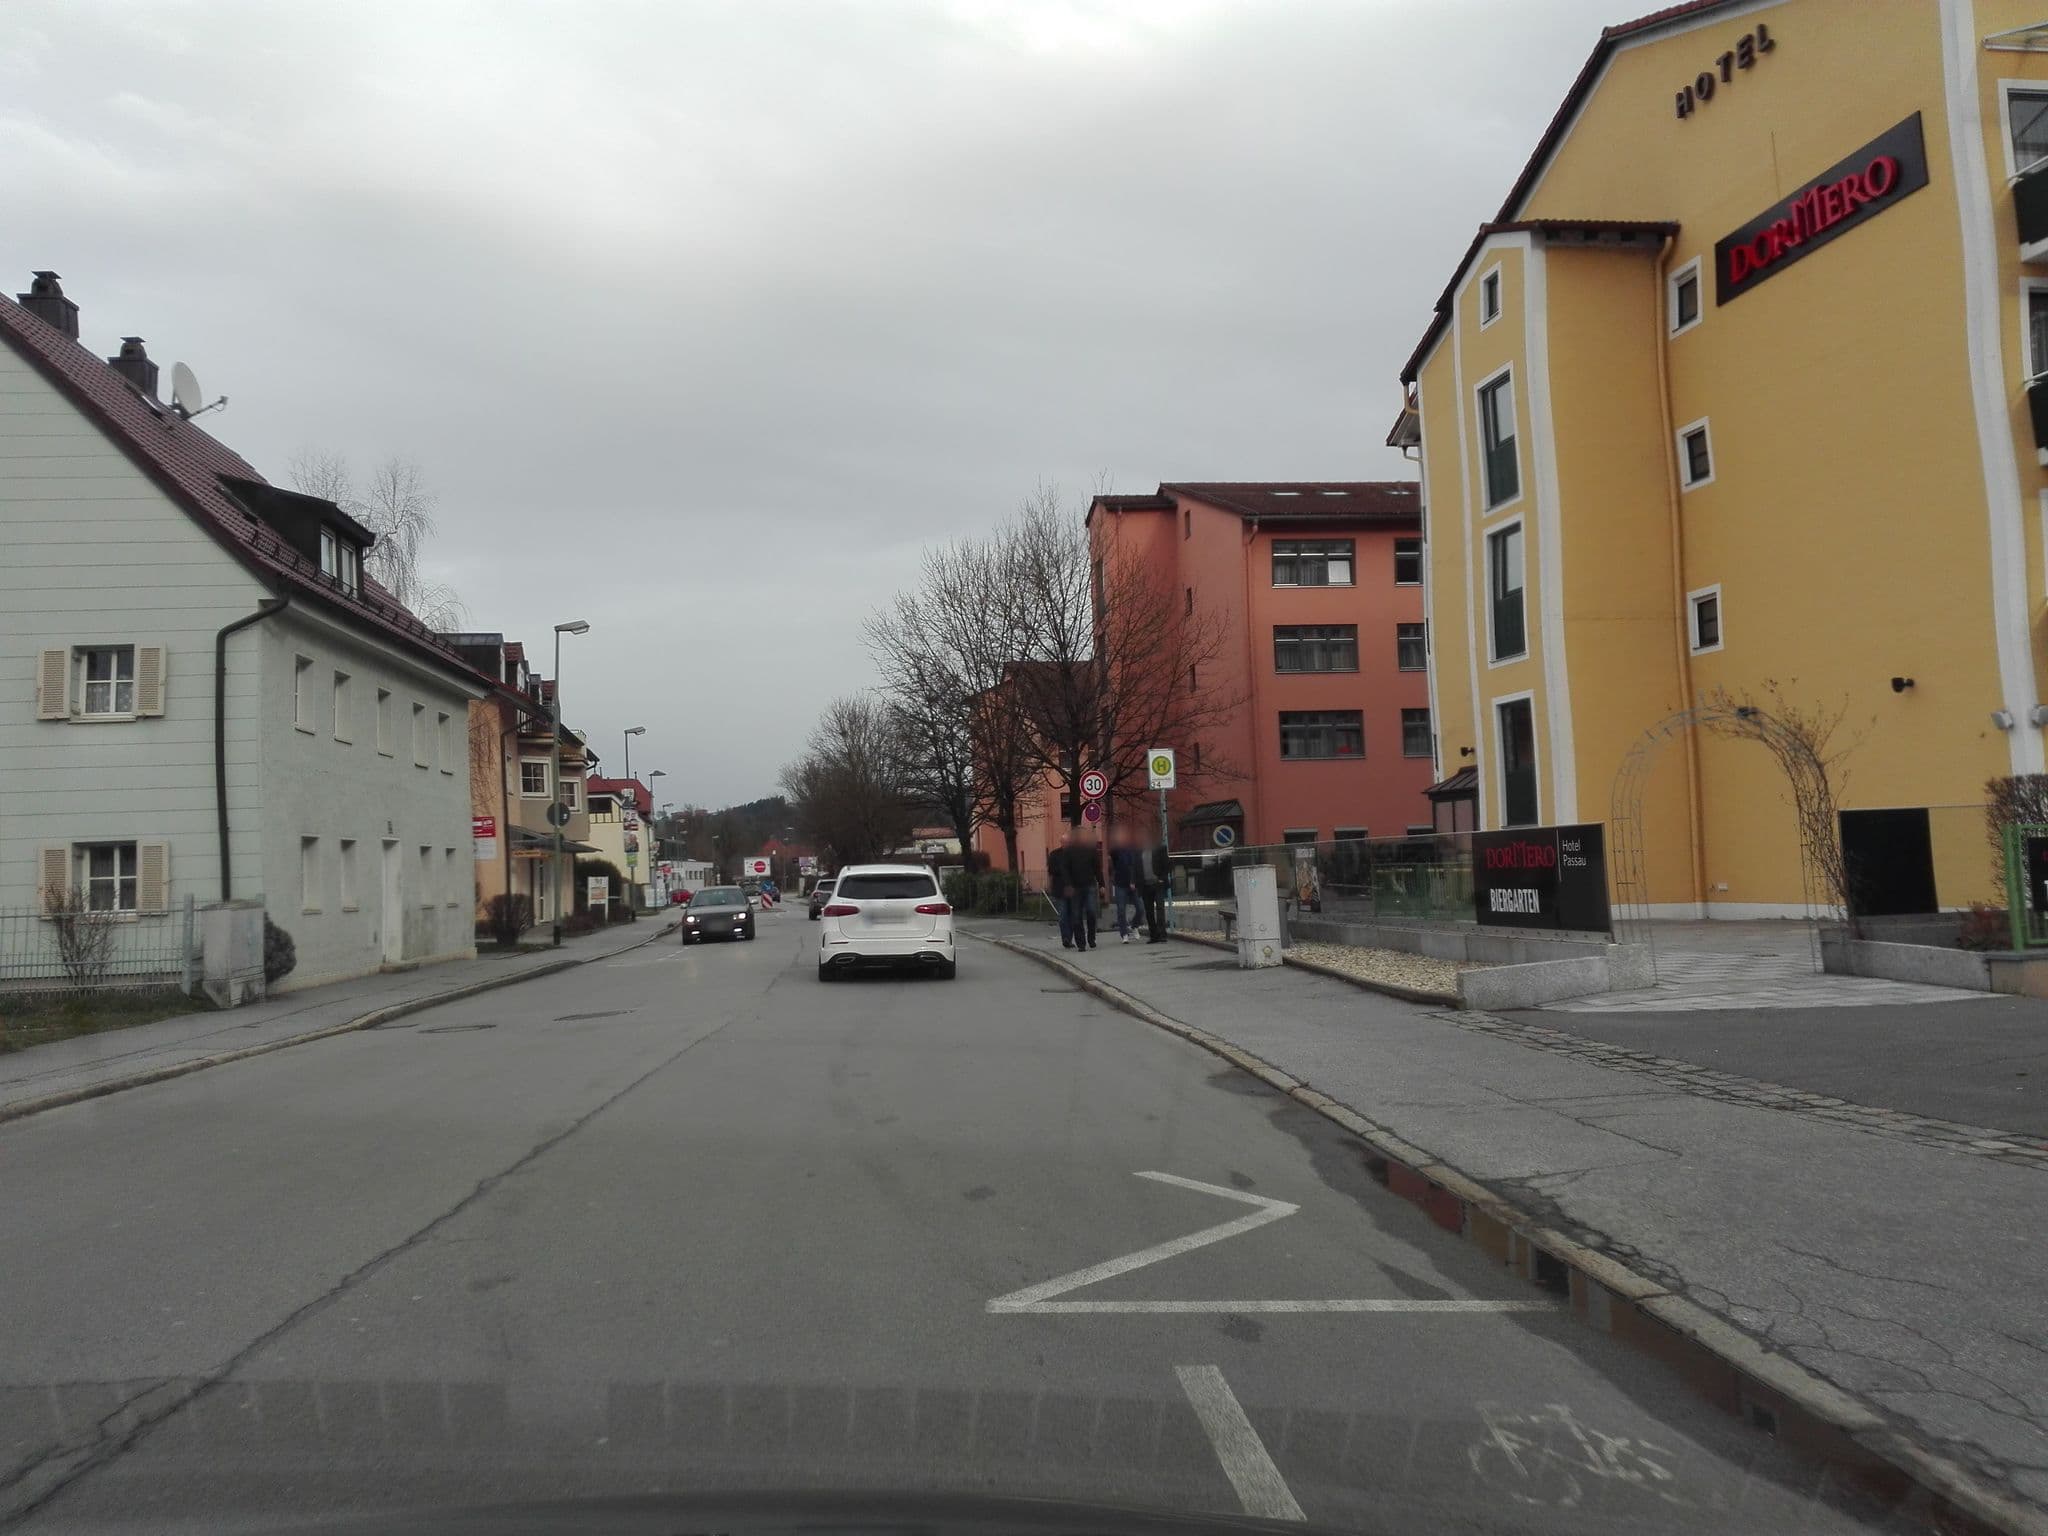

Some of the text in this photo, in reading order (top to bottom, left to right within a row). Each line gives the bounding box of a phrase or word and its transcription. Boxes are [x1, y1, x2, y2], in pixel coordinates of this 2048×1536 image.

[1675, 23, 1776, 120] HOTEL
[1729, 155, 1899, 284] DORMERO
[1157, 760, 1166, 771] H
[1086, 778, 1101, 791] 30
[1562, 838, 1581, 851] Hotel
[1486, 841, 1555, 868] DORMERO
[1563, 854, 1586, 867] Passau
[1490, 888, 1540, 914] BIERGARTEN
